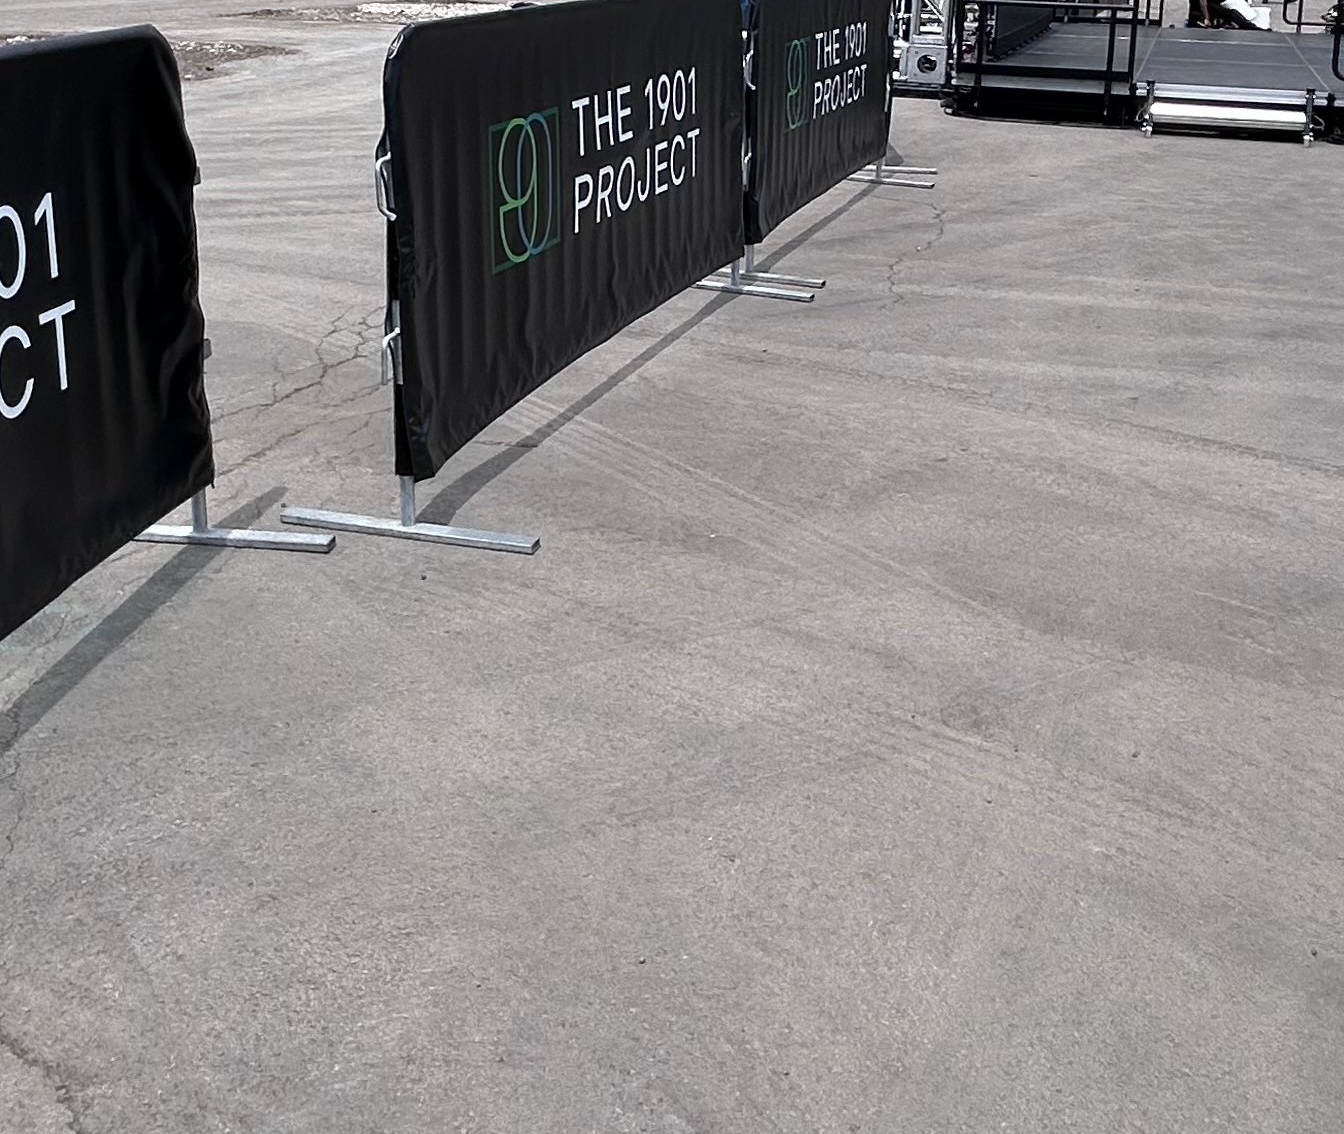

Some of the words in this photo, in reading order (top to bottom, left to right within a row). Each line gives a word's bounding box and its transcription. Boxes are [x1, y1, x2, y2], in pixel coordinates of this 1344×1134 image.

[815, 28, 840, 70] THE
[844, 20, 868, 61] 1901
[572, 85, 634, 157] THE
[644, 66, 696, 131] 1901
[813, 64, 868, 119] PROJECT
[574, 128, 701, 234] PROJECT
